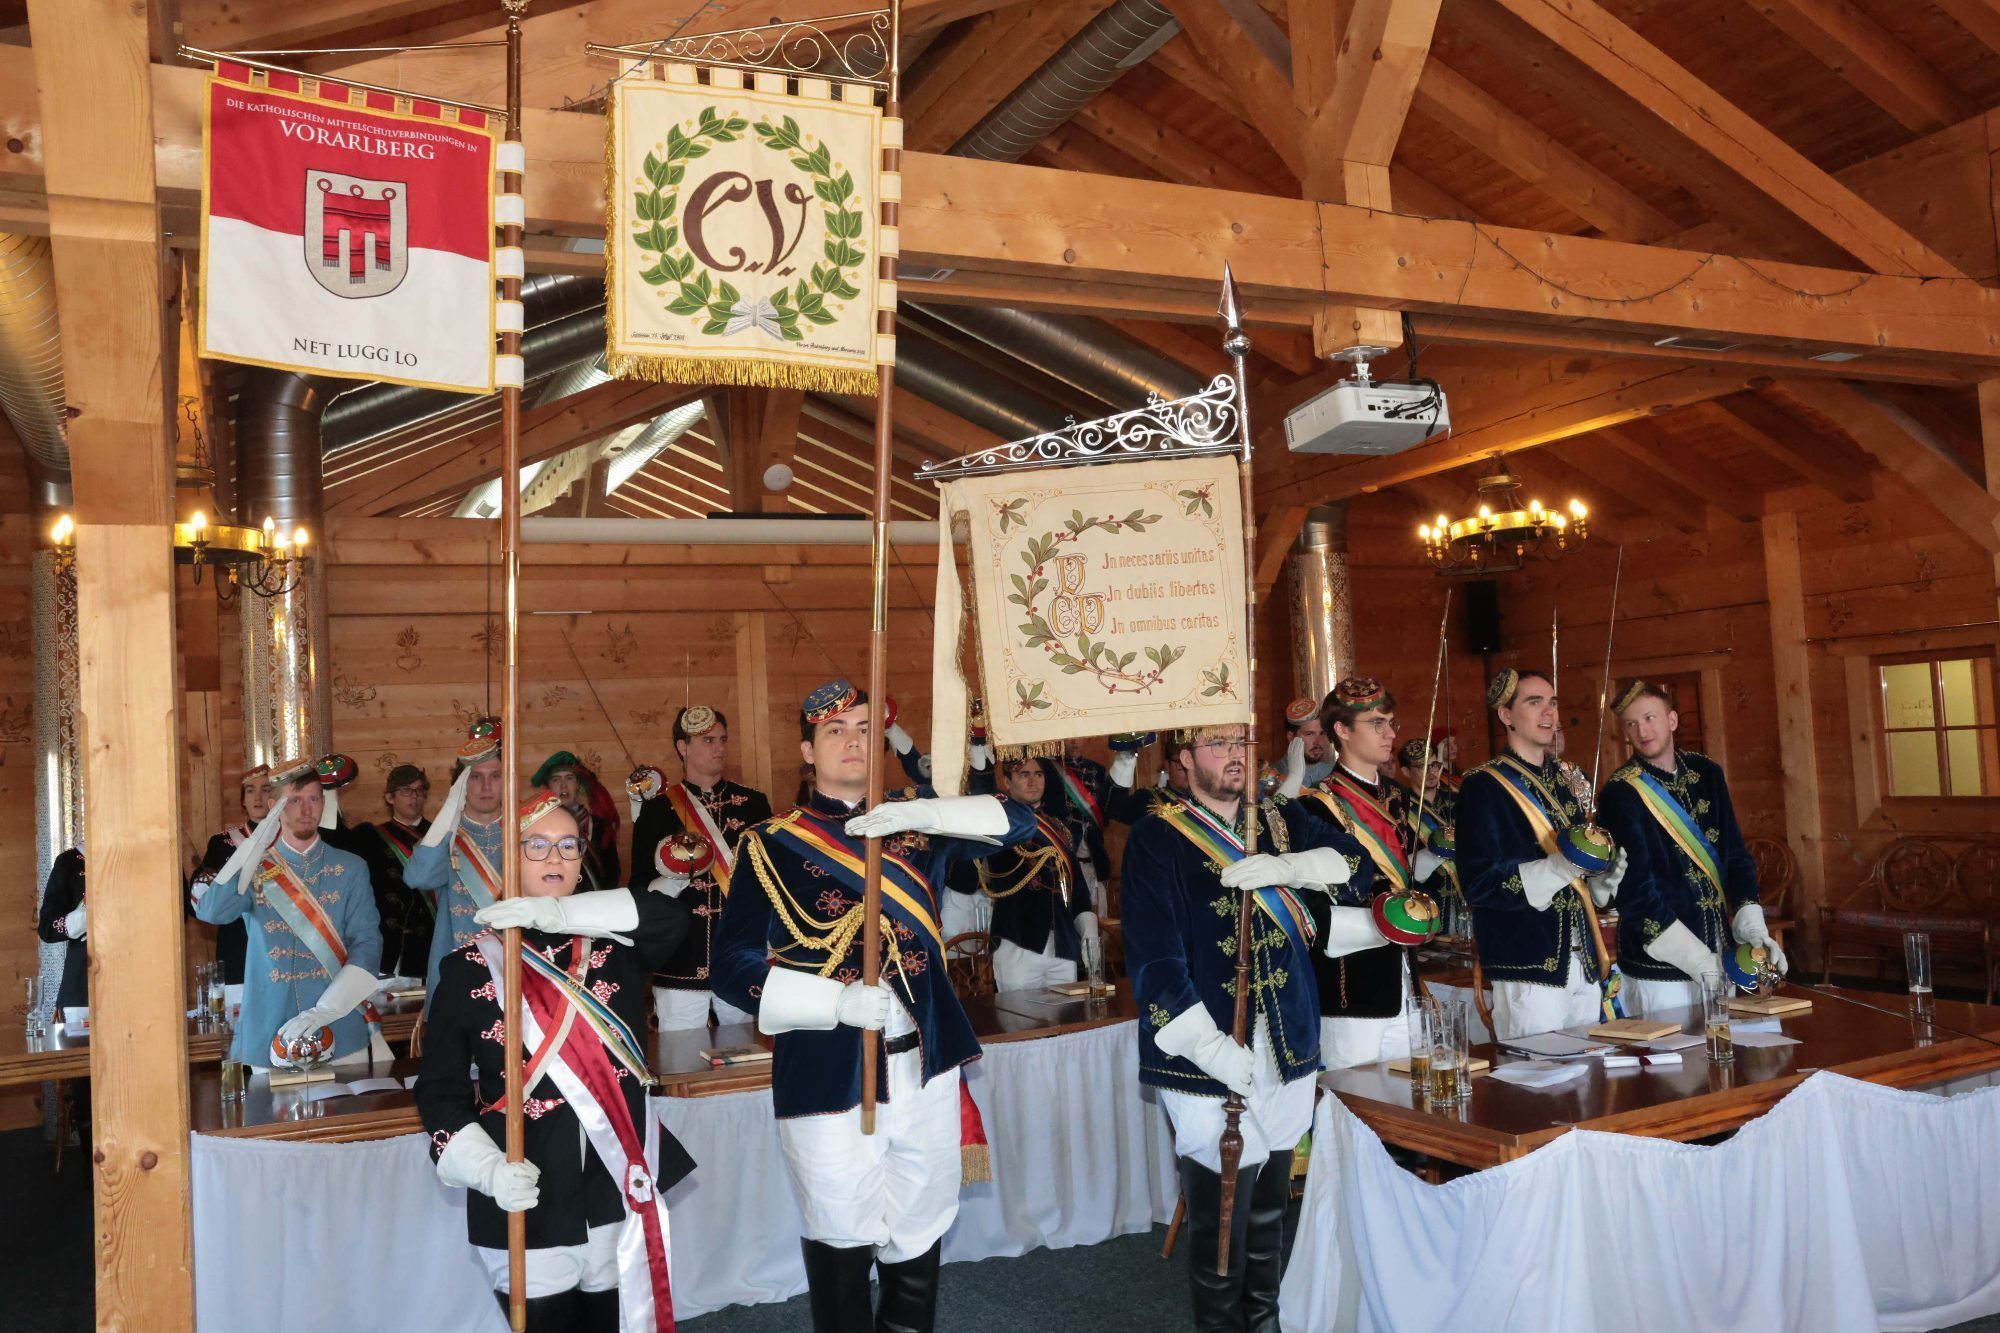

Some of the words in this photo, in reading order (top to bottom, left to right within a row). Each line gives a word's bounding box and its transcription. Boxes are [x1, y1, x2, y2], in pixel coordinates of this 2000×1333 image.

[226, 98, 244, 109] DIE
[247, 103, 324, 124] KATHOLISCHEN
[327, 118, 465, 148] MITTELSCHULVERBINDUNGEN
[467, 143, 478, 153] IN
[279, 119, 435, 160] VORARLBERG
[293, 337, 331, 356] NET
[337, 344, 389, 362] LUGG
[395, 350, 418, 367] LO
[1119, 549, 1179, 568] necessariis
[1181, 548, 1214, 564] unitas
[1126, 582, 1165, 600] dubiis
[1169, 579, 1216, 598] libertas
[1129, 615, 1176, 633] omnibus
[1180, 612, 1220, 630] caritas
